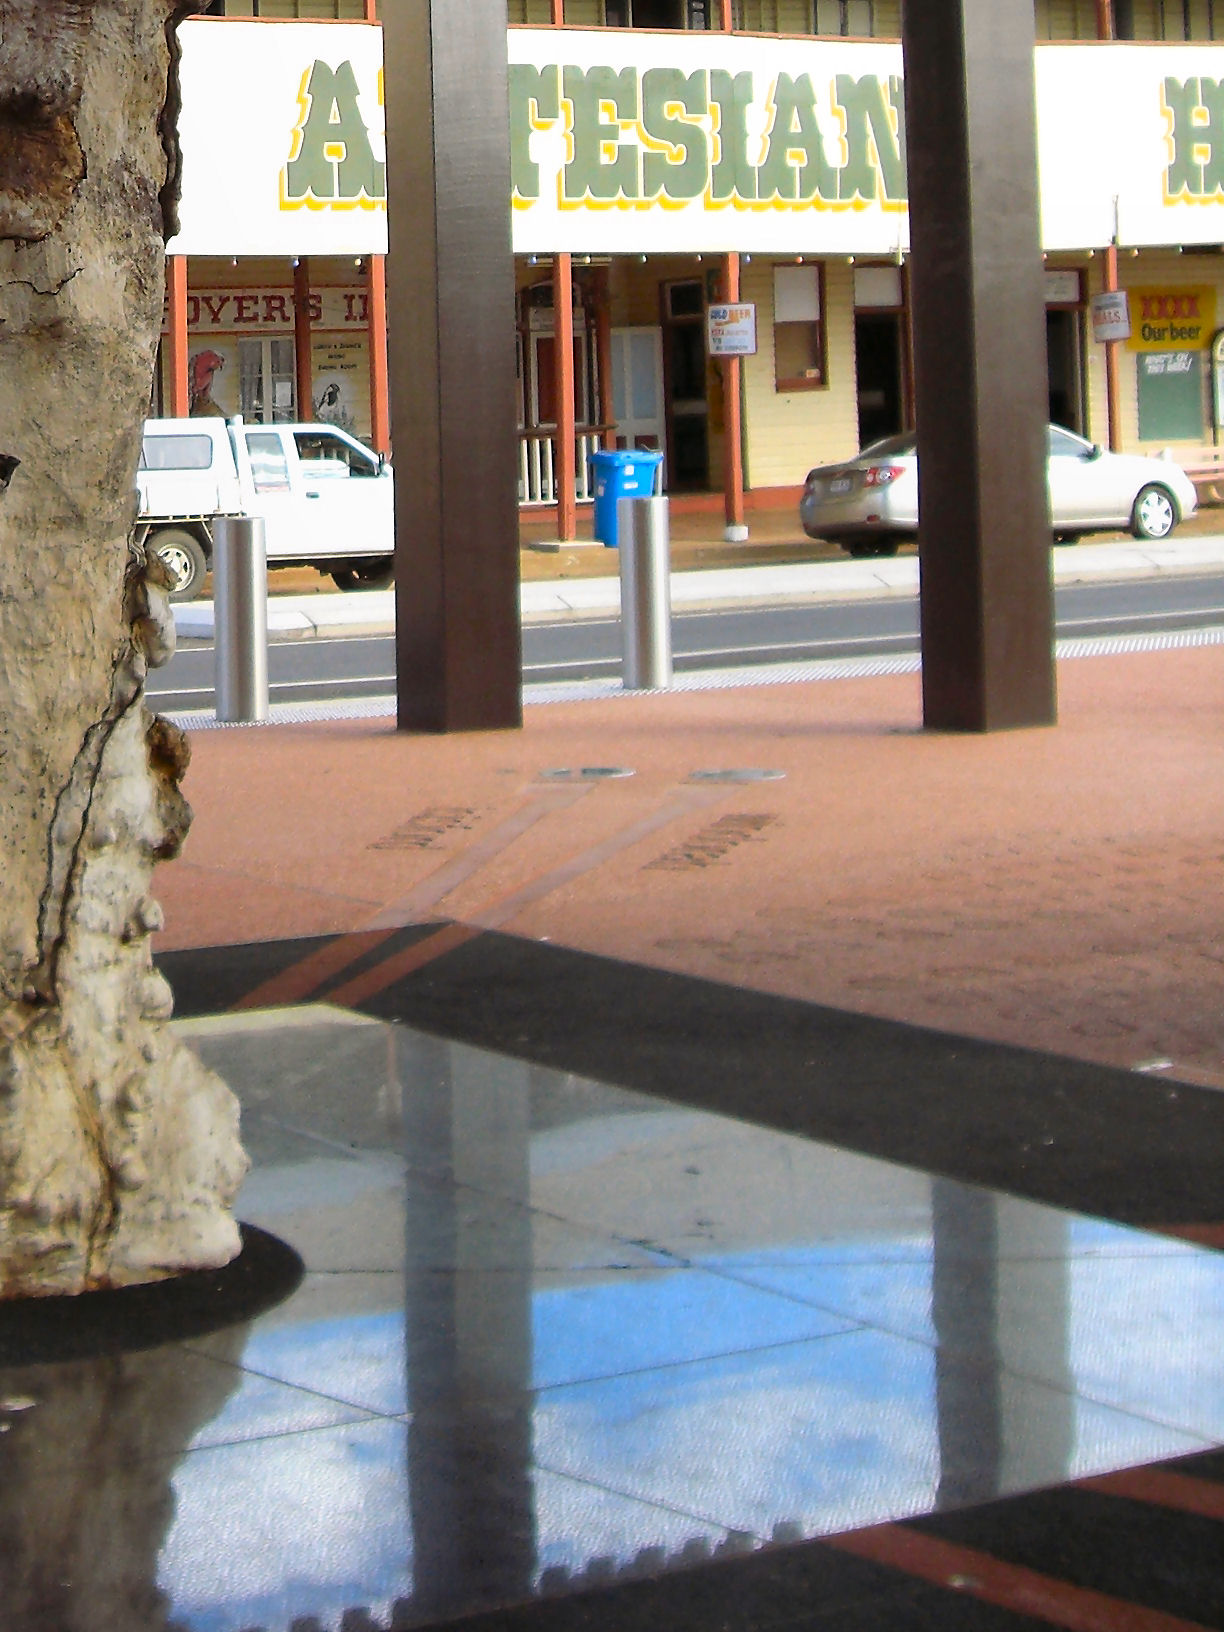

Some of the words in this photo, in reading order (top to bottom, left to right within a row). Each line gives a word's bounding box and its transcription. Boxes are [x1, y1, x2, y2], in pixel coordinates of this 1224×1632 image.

[281, 59, 908, 210] ATESIAN
[1140, 294, 1201, 320] XXXX
[1141, 322, 1168, 342] Our
[1170, 322, 1202, 341] beer
